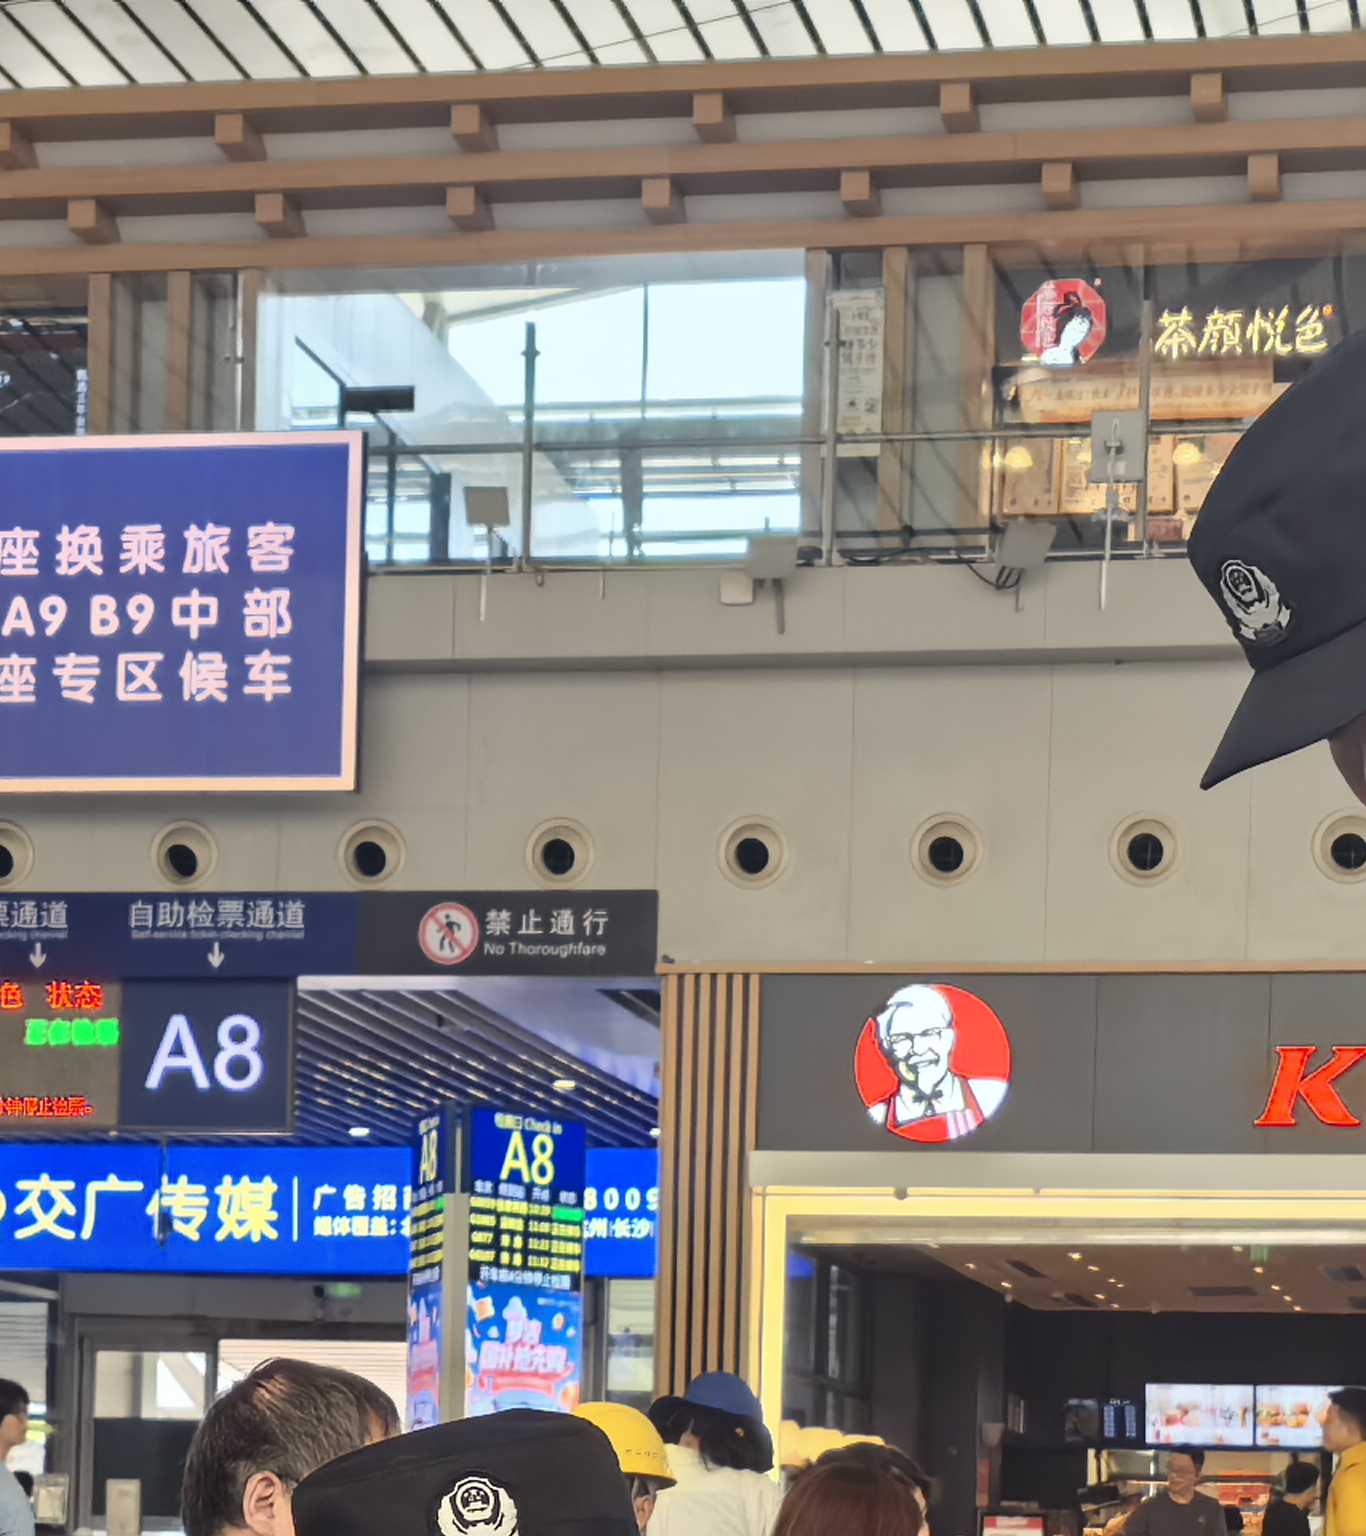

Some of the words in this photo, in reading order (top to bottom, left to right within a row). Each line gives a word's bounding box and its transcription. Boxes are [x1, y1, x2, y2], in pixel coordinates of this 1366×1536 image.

[1154, 304, 1329, 359] 茶颜悦色
[129, 900, 305, 929] 自助检票通道
[486, 908, 609, 936] 禁止通行
[484, 942, 505, 956] No
[509, 941, 607, 959] Thoroughfare
[46, 981, 103, 1010] 状态
[144, 1013, 264, 1091] A8
[500, 1130, 555, 1186] A8
[14, 1173, 279, 1242] 交广传媒
